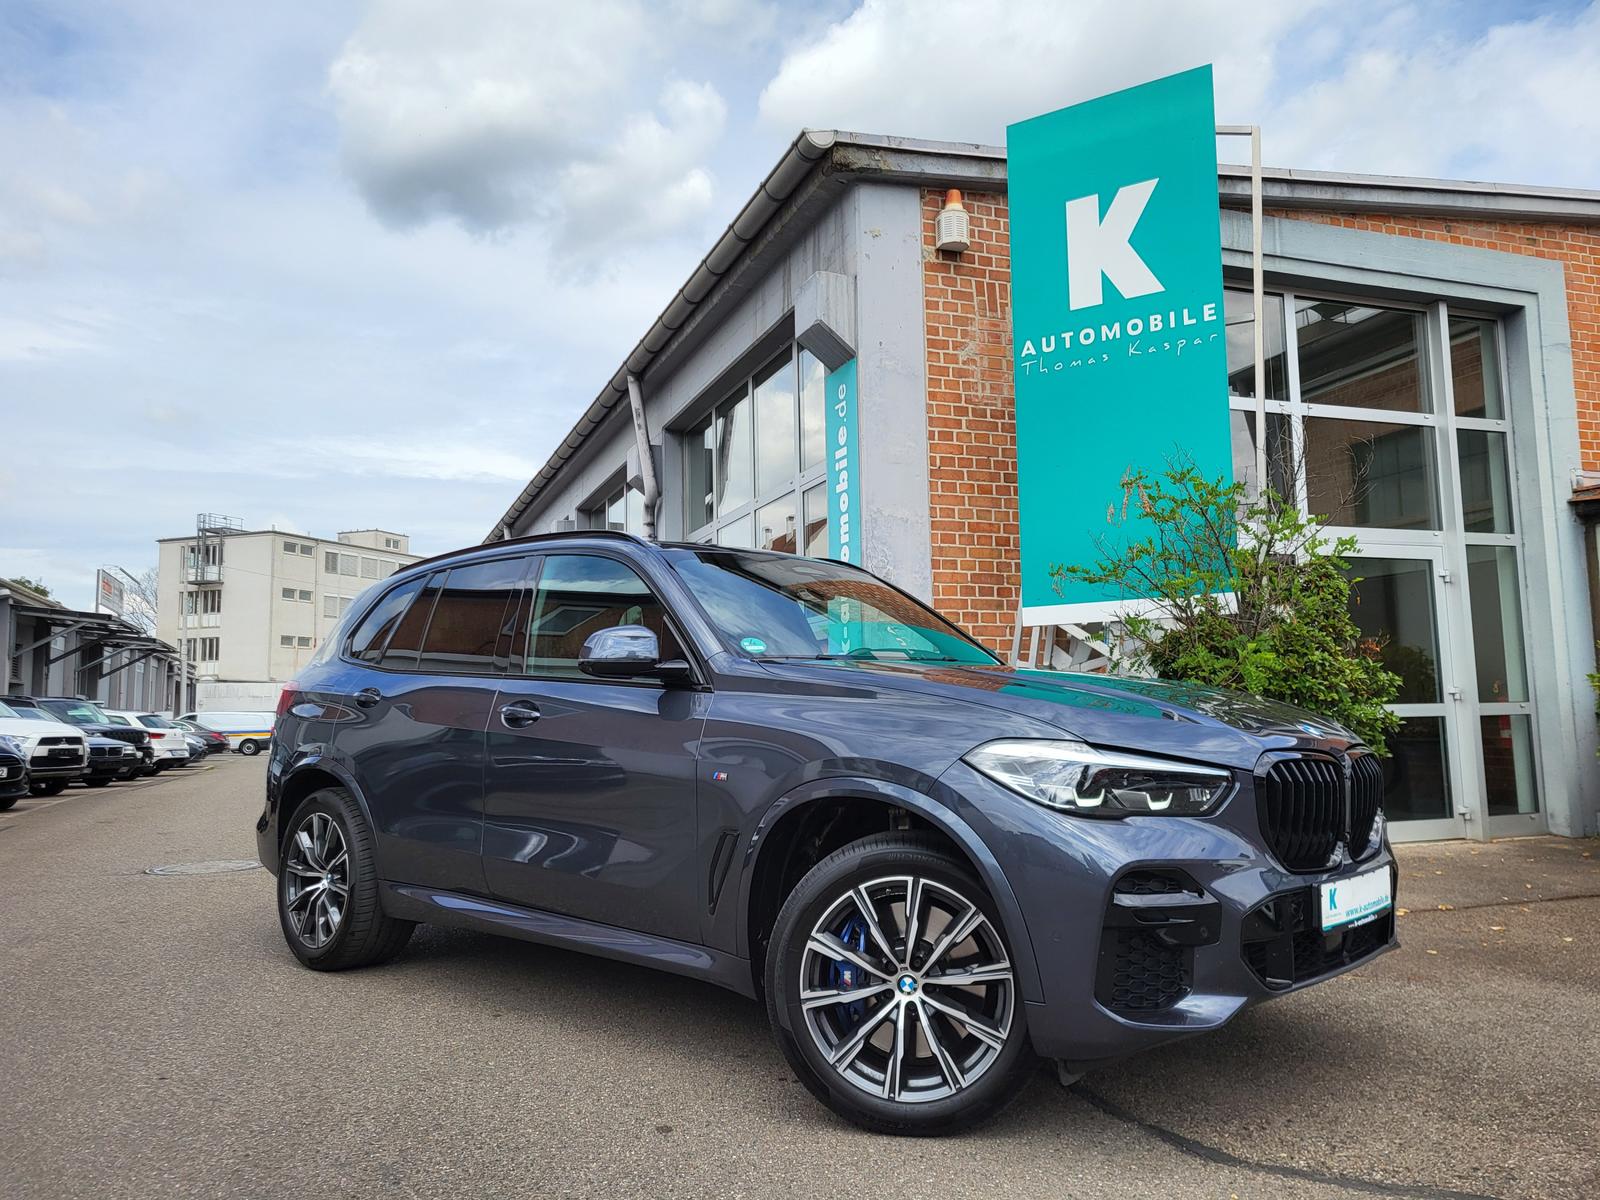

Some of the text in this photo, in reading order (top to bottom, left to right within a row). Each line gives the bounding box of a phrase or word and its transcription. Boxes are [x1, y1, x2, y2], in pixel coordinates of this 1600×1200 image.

[1065, 177, 1166, 312] K
[1020, 302, 1218, 358] AUTOMOBILE
[1020, 333, 1219, 376] Thomas Kaspar
[1329, 887, 1338, 911] K
